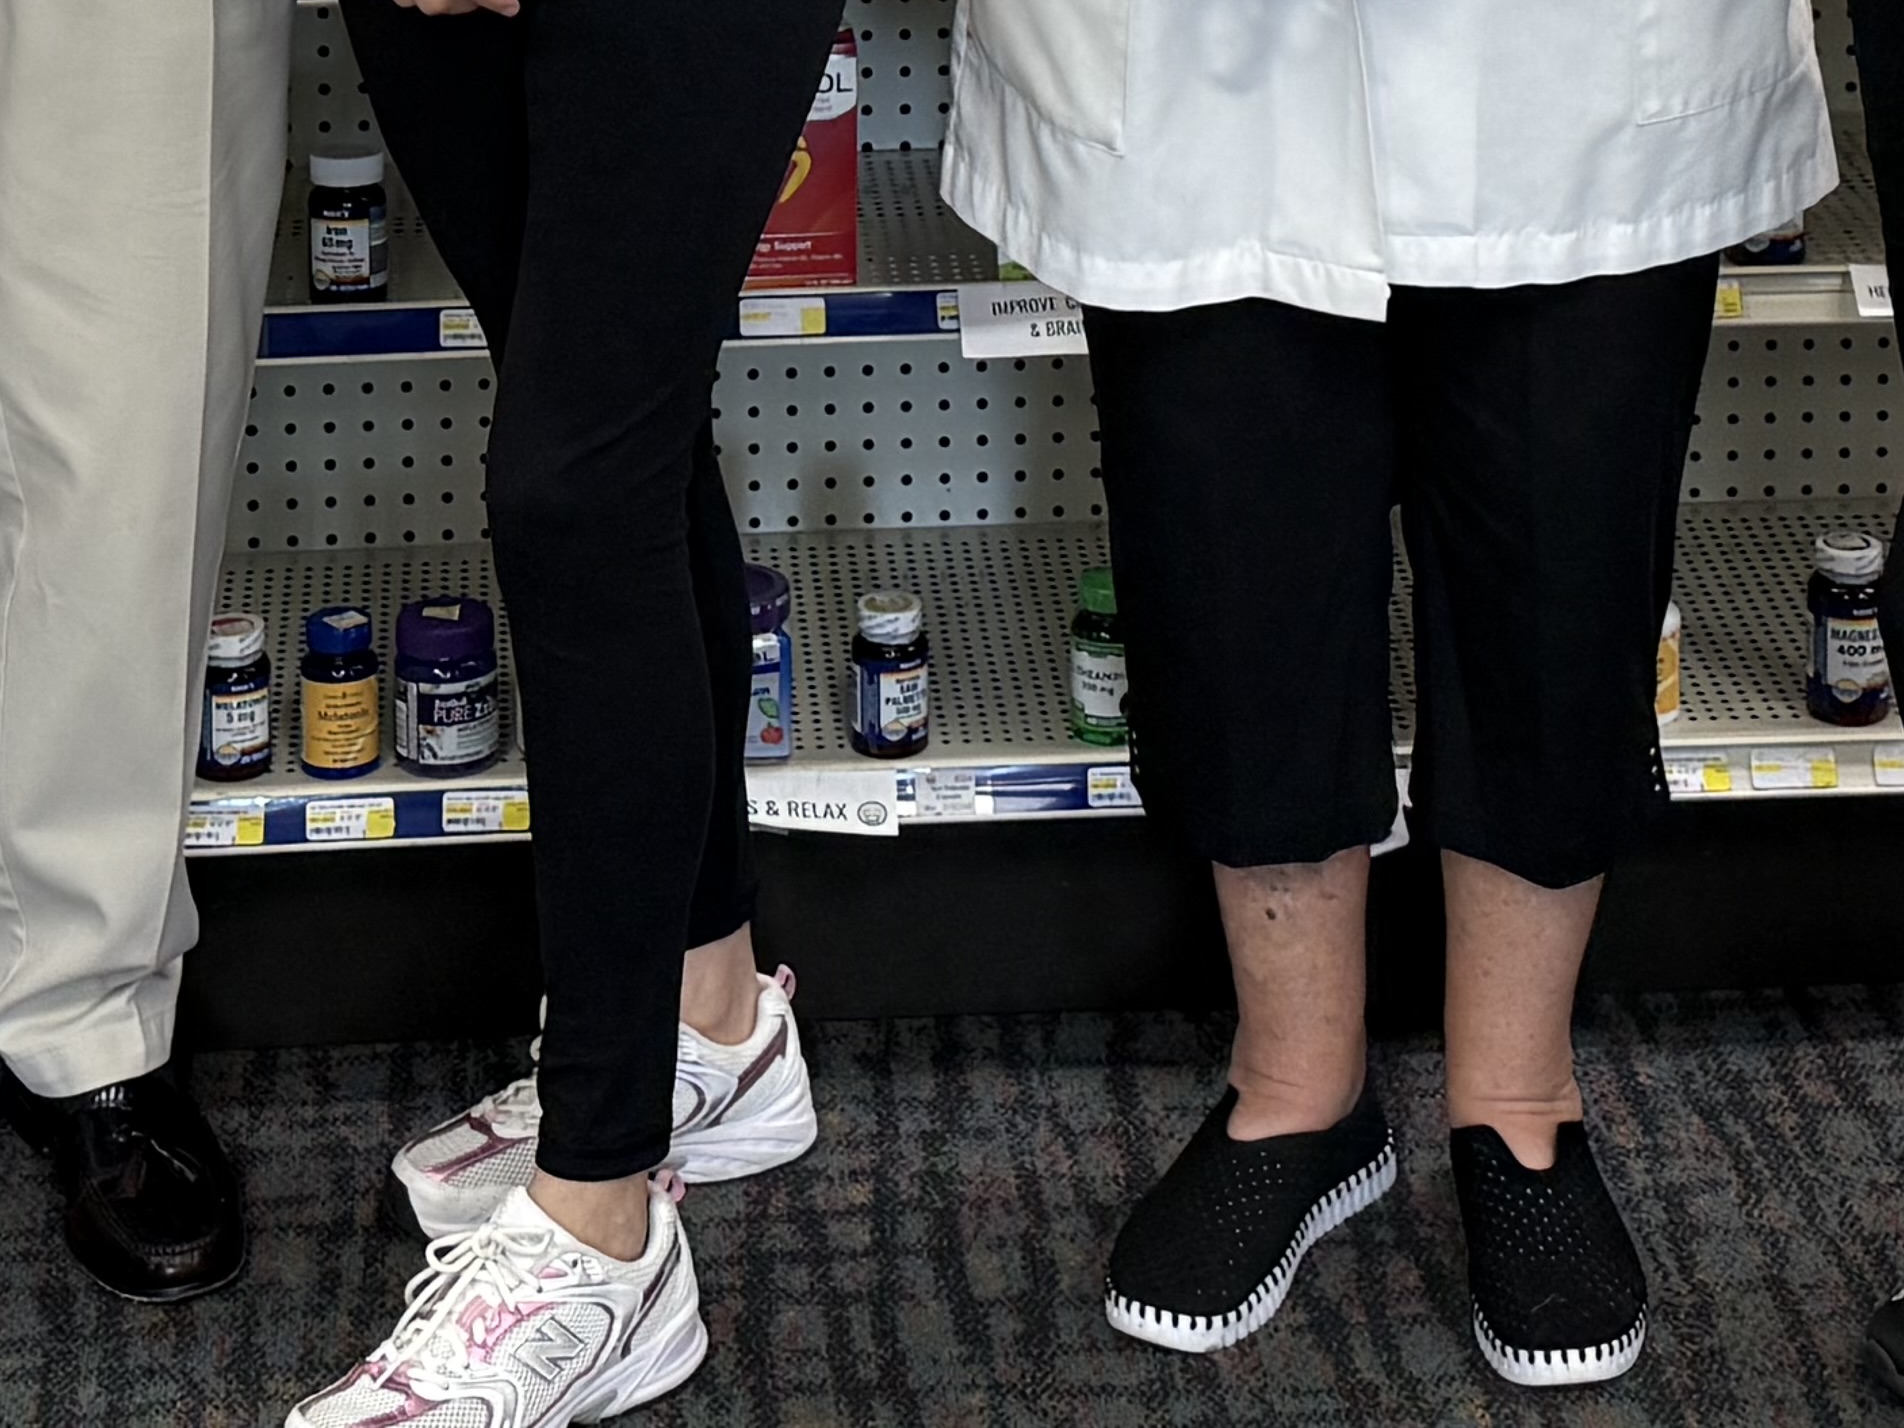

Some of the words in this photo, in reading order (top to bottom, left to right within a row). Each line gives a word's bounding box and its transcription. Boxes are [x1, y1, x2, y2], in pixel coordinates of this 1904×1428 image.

[774, 241, 812, 251] Support
[992, 296, 1056, 316] IMPROVE
[1046, 320, 1081, 336] BRAI
[1837, 645, 1867, 656] 400
[433, 710, 473, 723] PURE
[767, 799, 780, 817] &
[788, 800, 848, 821] RELAX
